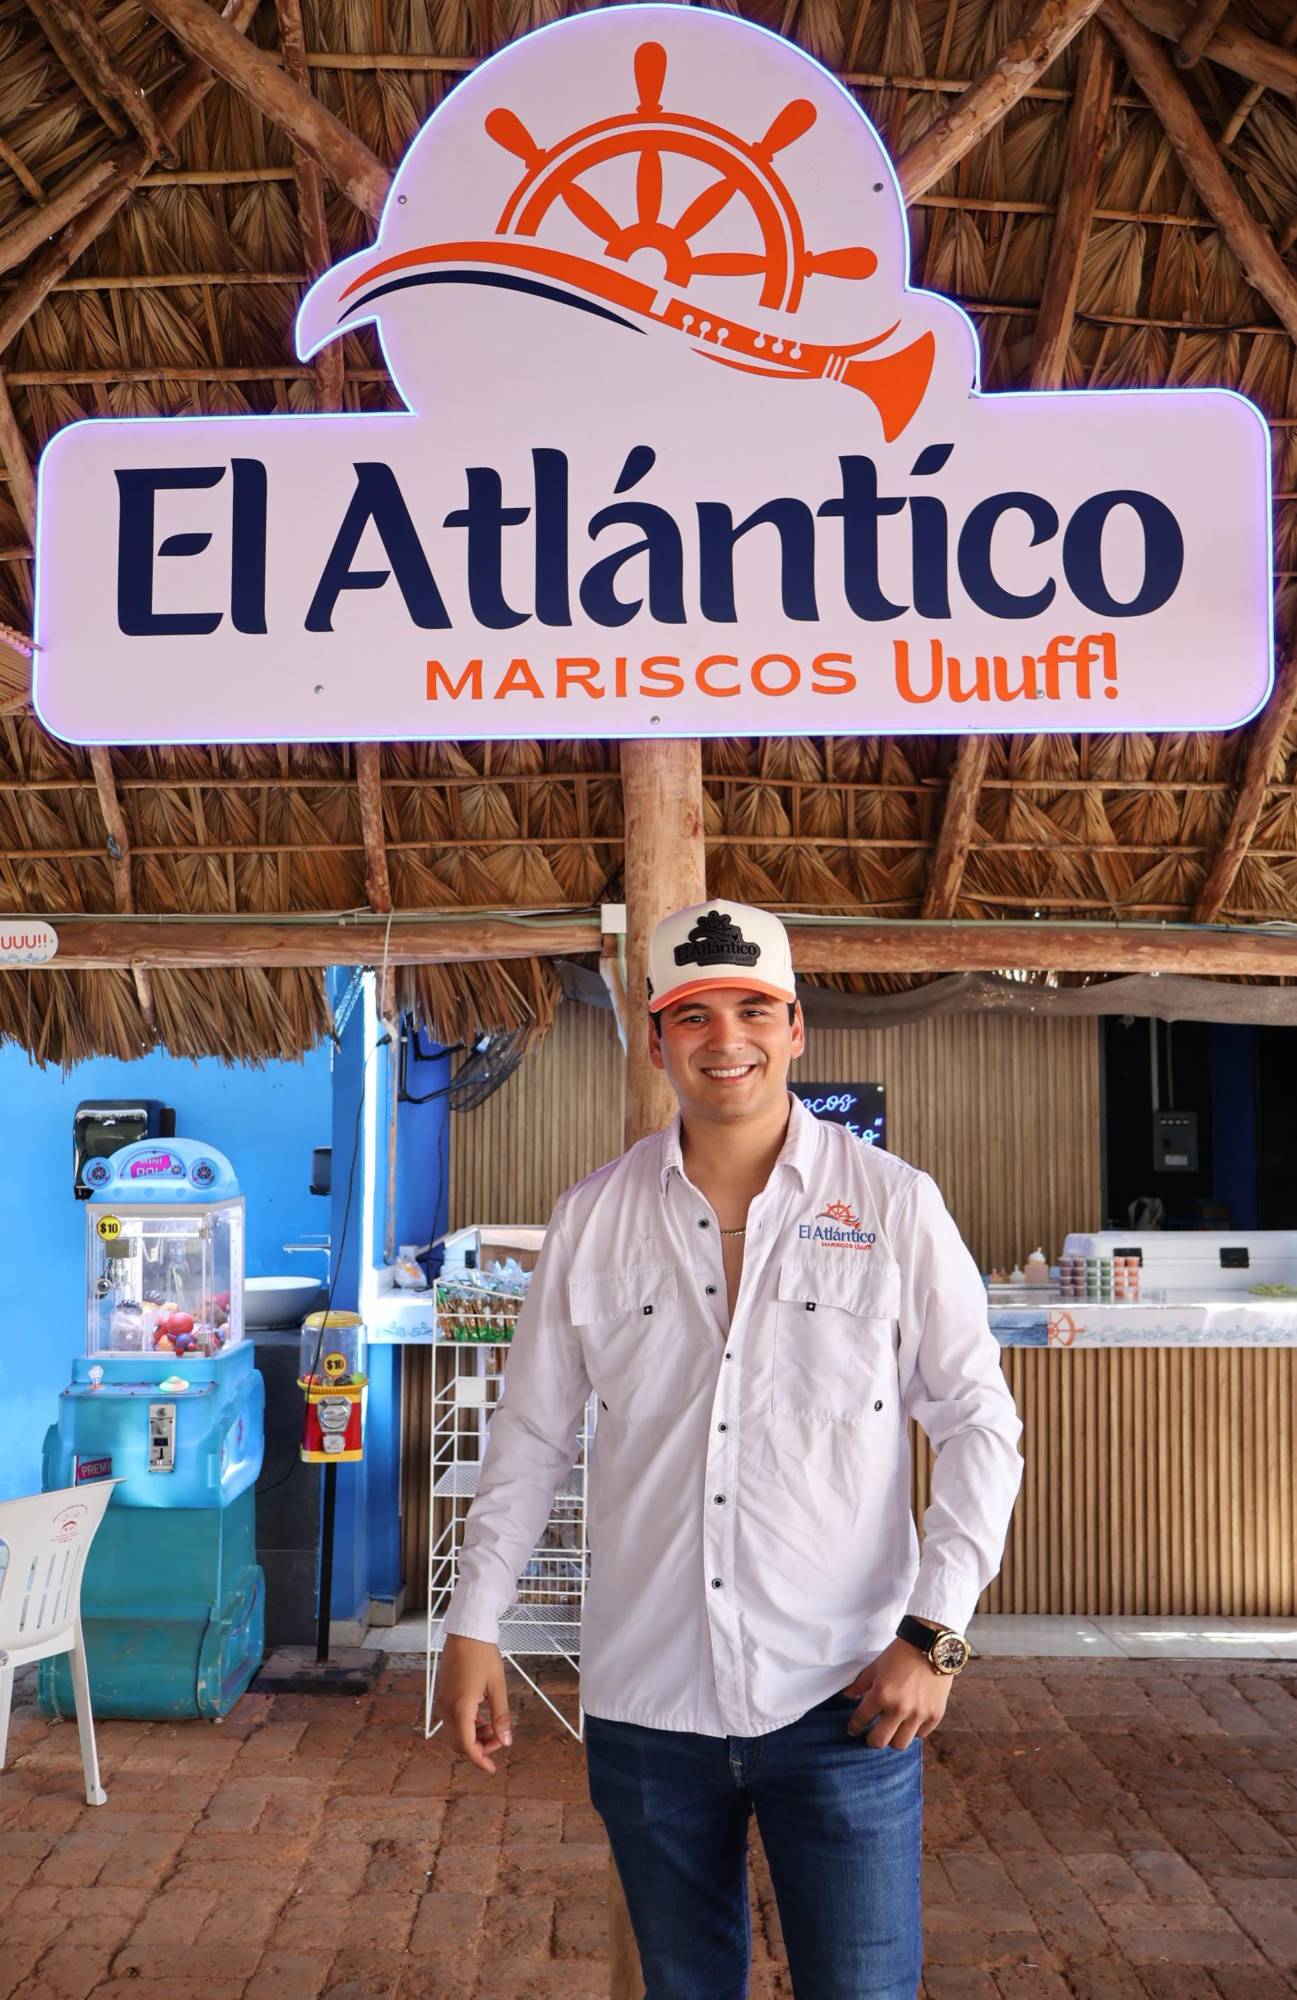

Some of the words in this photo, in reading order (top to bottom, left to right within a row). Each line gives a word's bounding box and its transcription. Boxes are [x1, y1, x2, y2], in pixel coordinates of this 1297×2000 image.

[114, 458, 268, 636] El
[305, 444, 1185, 634] Atlántico
[427, 654, 858, 701] MARISCOS
[894, 632, 1119, 704] Uuuff!
[100, 1223, 118, 1234] $10
[799, 1225, 811, 1240] El
[813, 1226, 876, 1244] Atlántico
